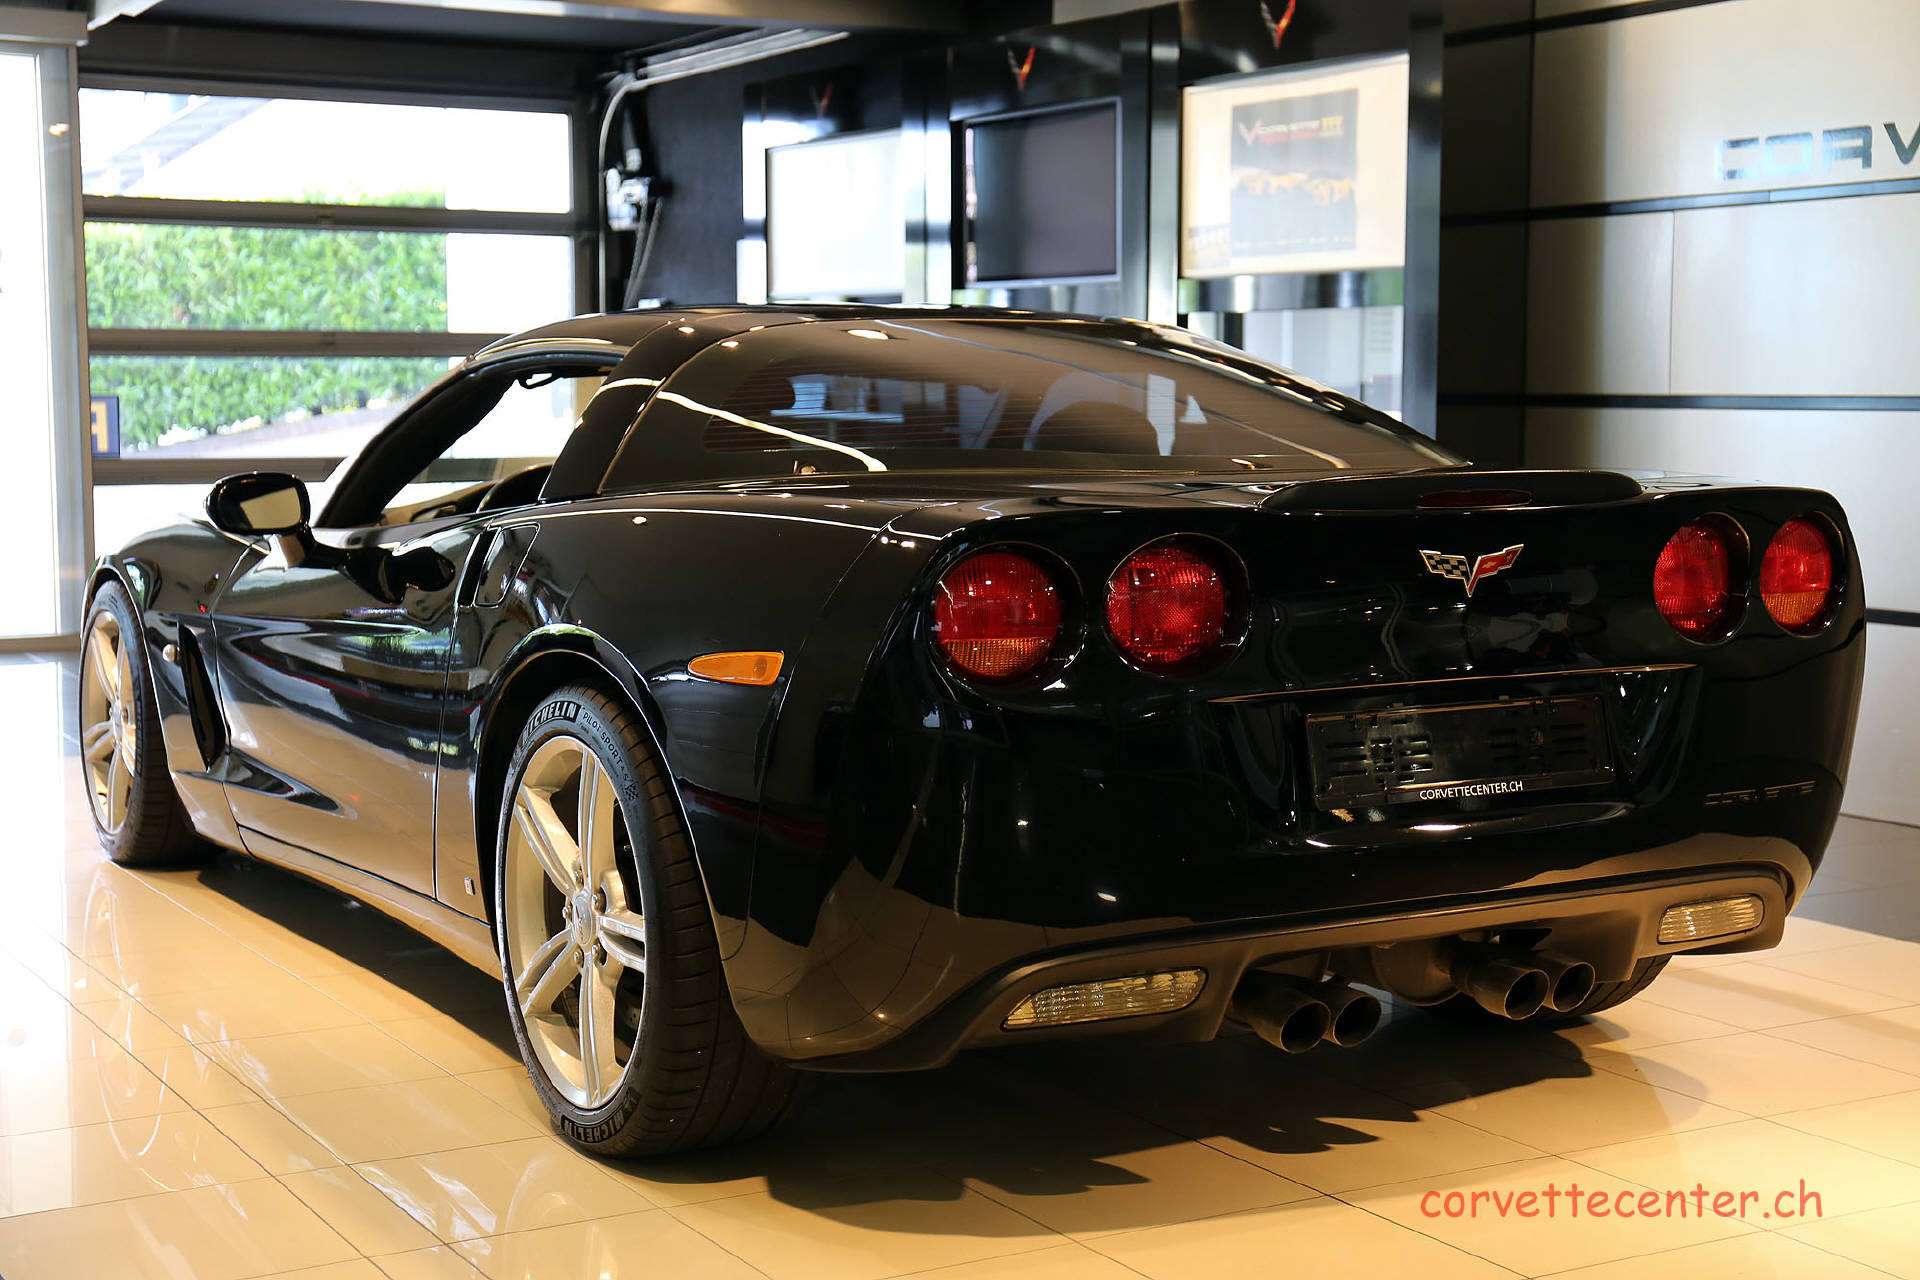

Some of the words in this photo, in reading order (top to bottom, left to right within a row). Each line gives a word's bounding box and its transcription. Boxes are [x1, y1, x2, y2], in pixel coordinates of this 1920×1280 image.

[522, 700, 578, 746] MICHELIN
[582, 711, 602, 733] PILOT
[600, 731, 623, 766] SPORT
[1419, 780, 1524, 801] CORVETTECENTER.CH
[563, 1110, 625, 1143] MICHELIN
